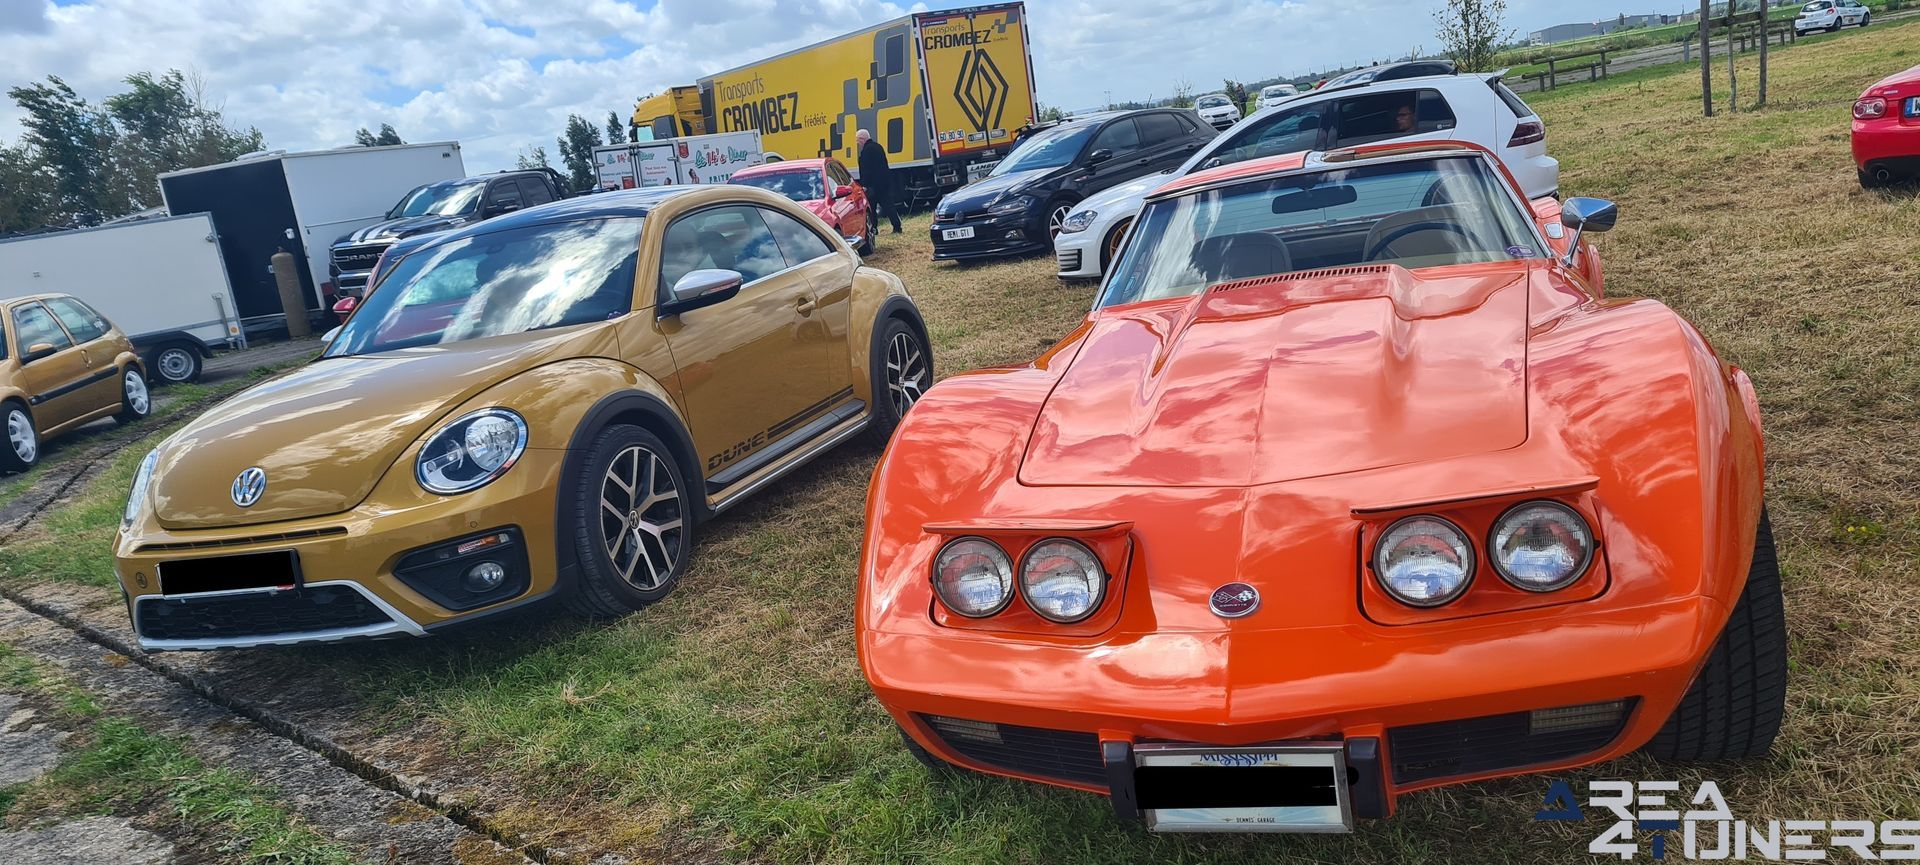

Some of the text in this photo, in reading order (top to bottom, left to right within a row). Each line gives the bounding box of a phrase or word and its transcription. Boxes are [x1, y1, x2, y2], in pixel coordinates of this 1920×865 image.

[924, 23, 965, 35] Transports
[924, 29, 991, 50] CROMBEZ
[715, 72, 764, 103] Transports
[723, 92, 802, 135] CROMBEZ
[970, 163, 997, 171] LAMBE
[708, 431, 765, 471] DUNE
